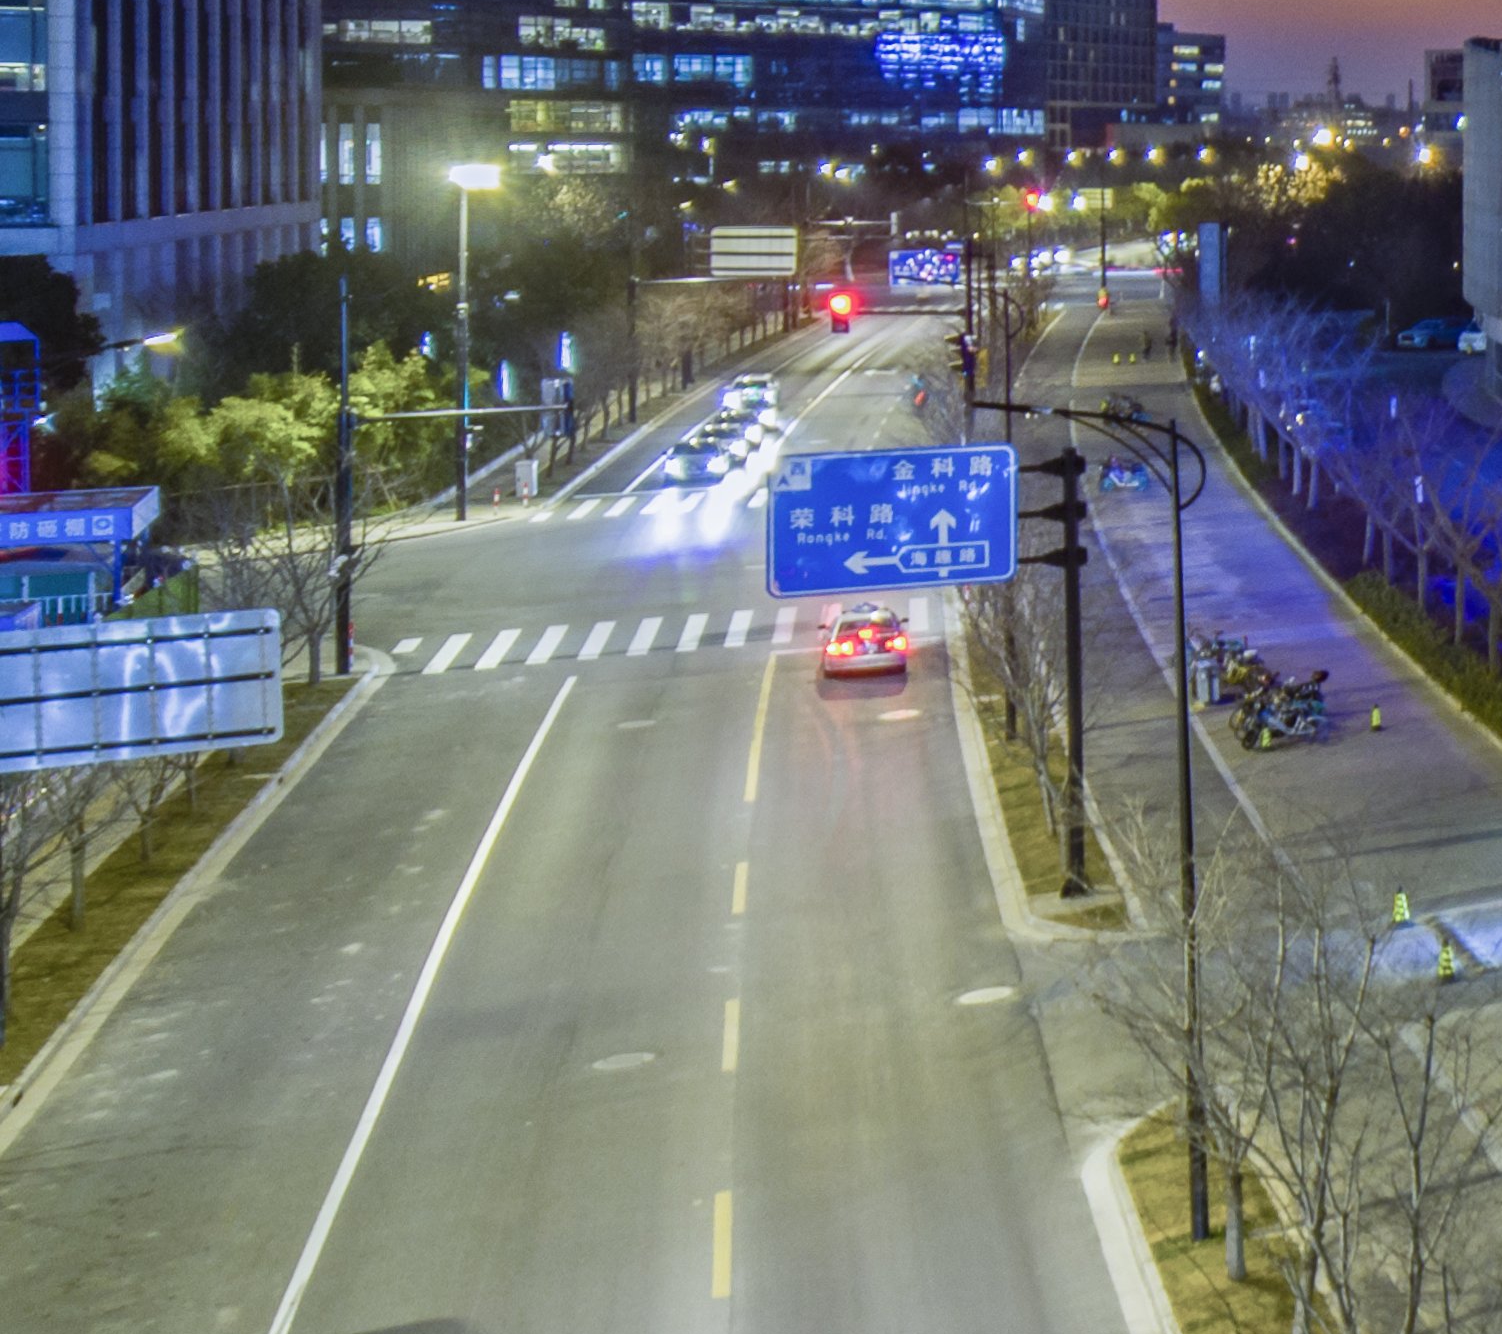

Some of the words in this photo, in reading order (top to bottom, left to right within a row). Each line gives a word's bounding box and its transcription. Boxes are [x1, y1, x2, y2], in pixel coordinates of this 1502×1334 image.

[892, 455, 992, 481] 金科路
[790, 503, 893, 529] 荣科路
[0, 518, 85, 541] 防砸棚
[797, 531, 850, 546] Rongke
